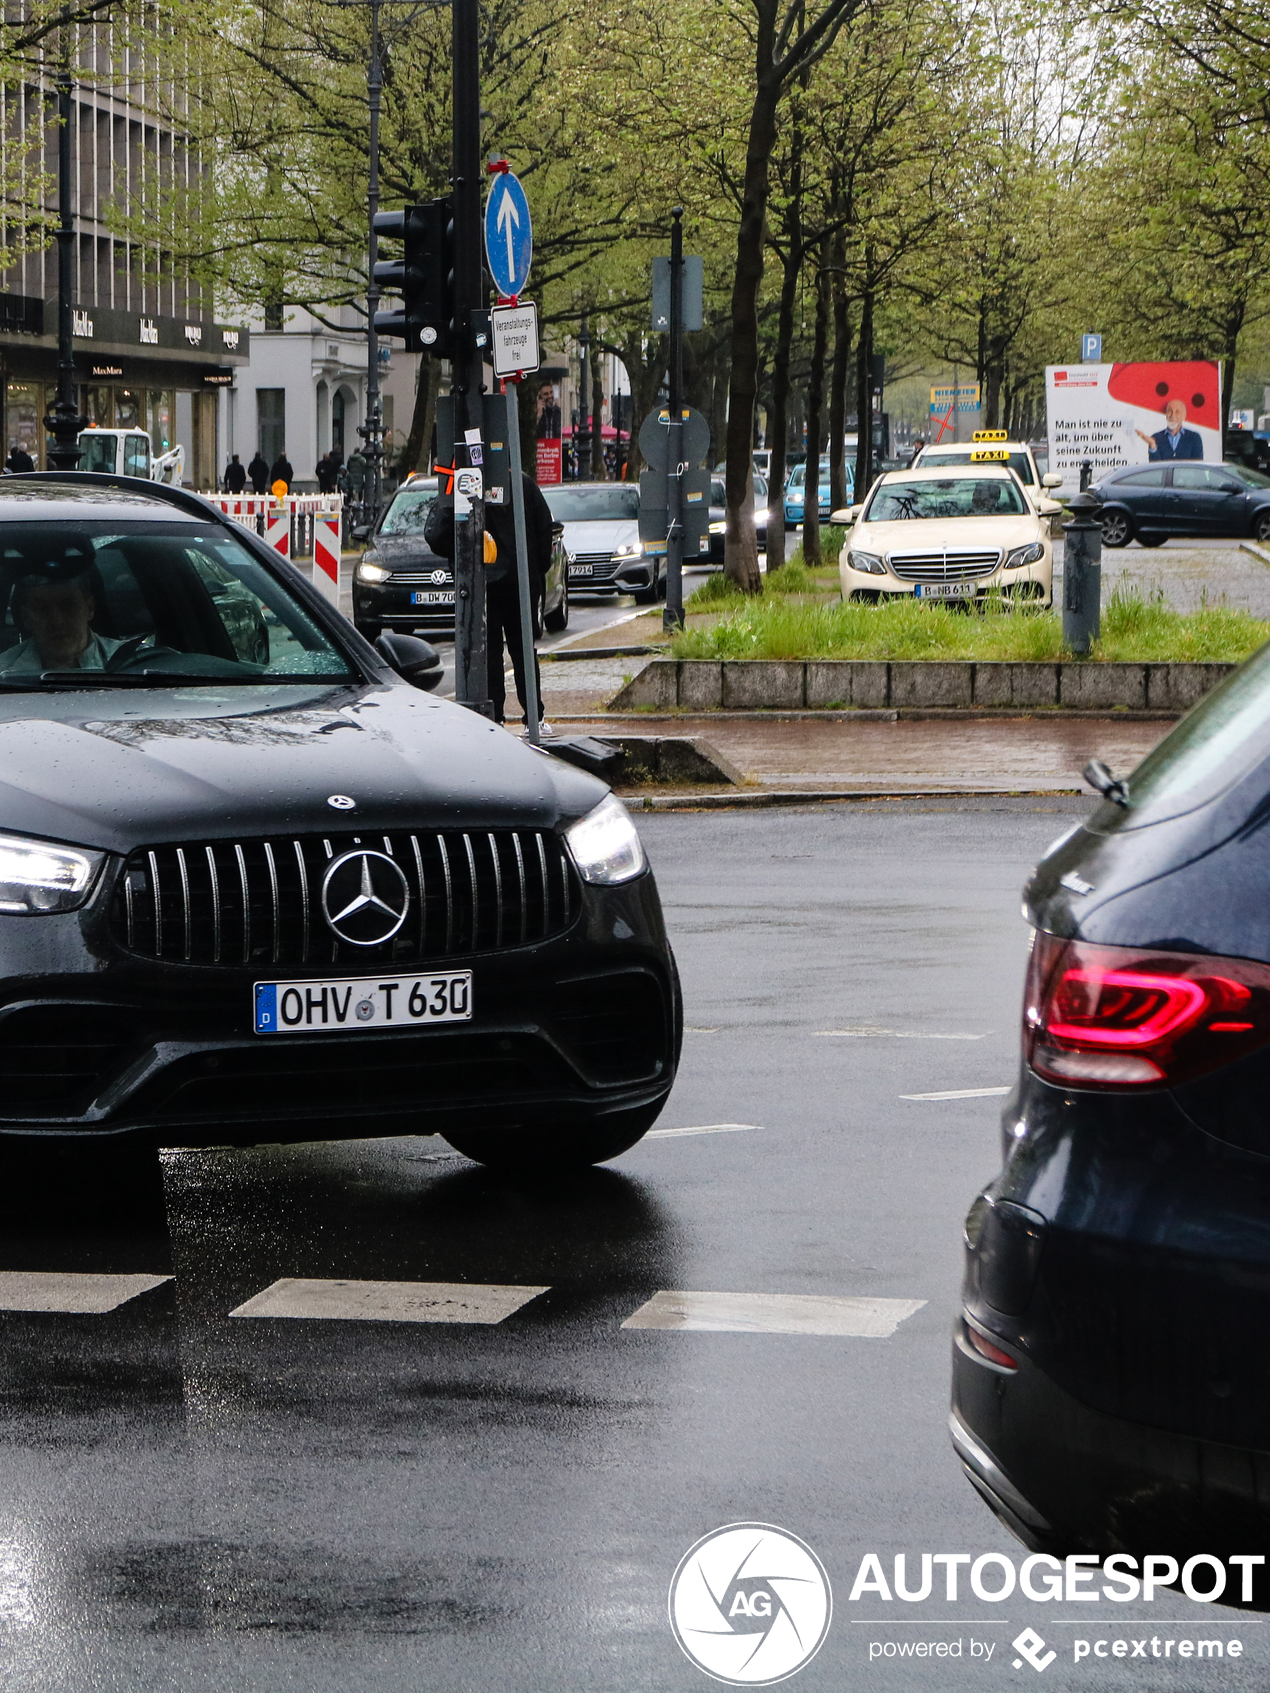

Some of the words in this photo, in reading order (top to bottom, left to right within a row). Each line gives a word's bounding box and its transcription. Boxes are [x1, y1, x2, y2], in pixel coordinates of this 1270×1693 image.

[495, 318, 533, 332] Veranstaltungs-
[504, 335, 528, 347] fahrzeuge
[1087, 337, 1098, 357] P
[512, 349, 521, 361] frei
[92, 366, 123, 375] MaxMara
[1055, 420, 1076, 429] Man
[1079, 419, 1091, 428] ist
[1093, 419, 1108, 428] nie
[1110, 420, 1122, 428] zu
[1055, 433, 1071, 443] alt,
[1091, 432, 1113, 442] über
[976, 451, 1004, 460] TAXI
[1056, 446, 1081, 455] seine
[1083, 445, 1122, 454] Zukunft
[1069, 457, 1130, 468] encheiden.
[925, 586, 931, 595] B
[937, 585, 951, 595] NB
[953, 584, 971, 594] 611
[416, 593, 422, 602] B
[429, 593, 440, 602] DW
[262, 1013, 270, 1024] D
[280, 986, 352, 1026] OHV
[379, 983, 399, 1020] T
[408, 978, 468, 1017] 630
